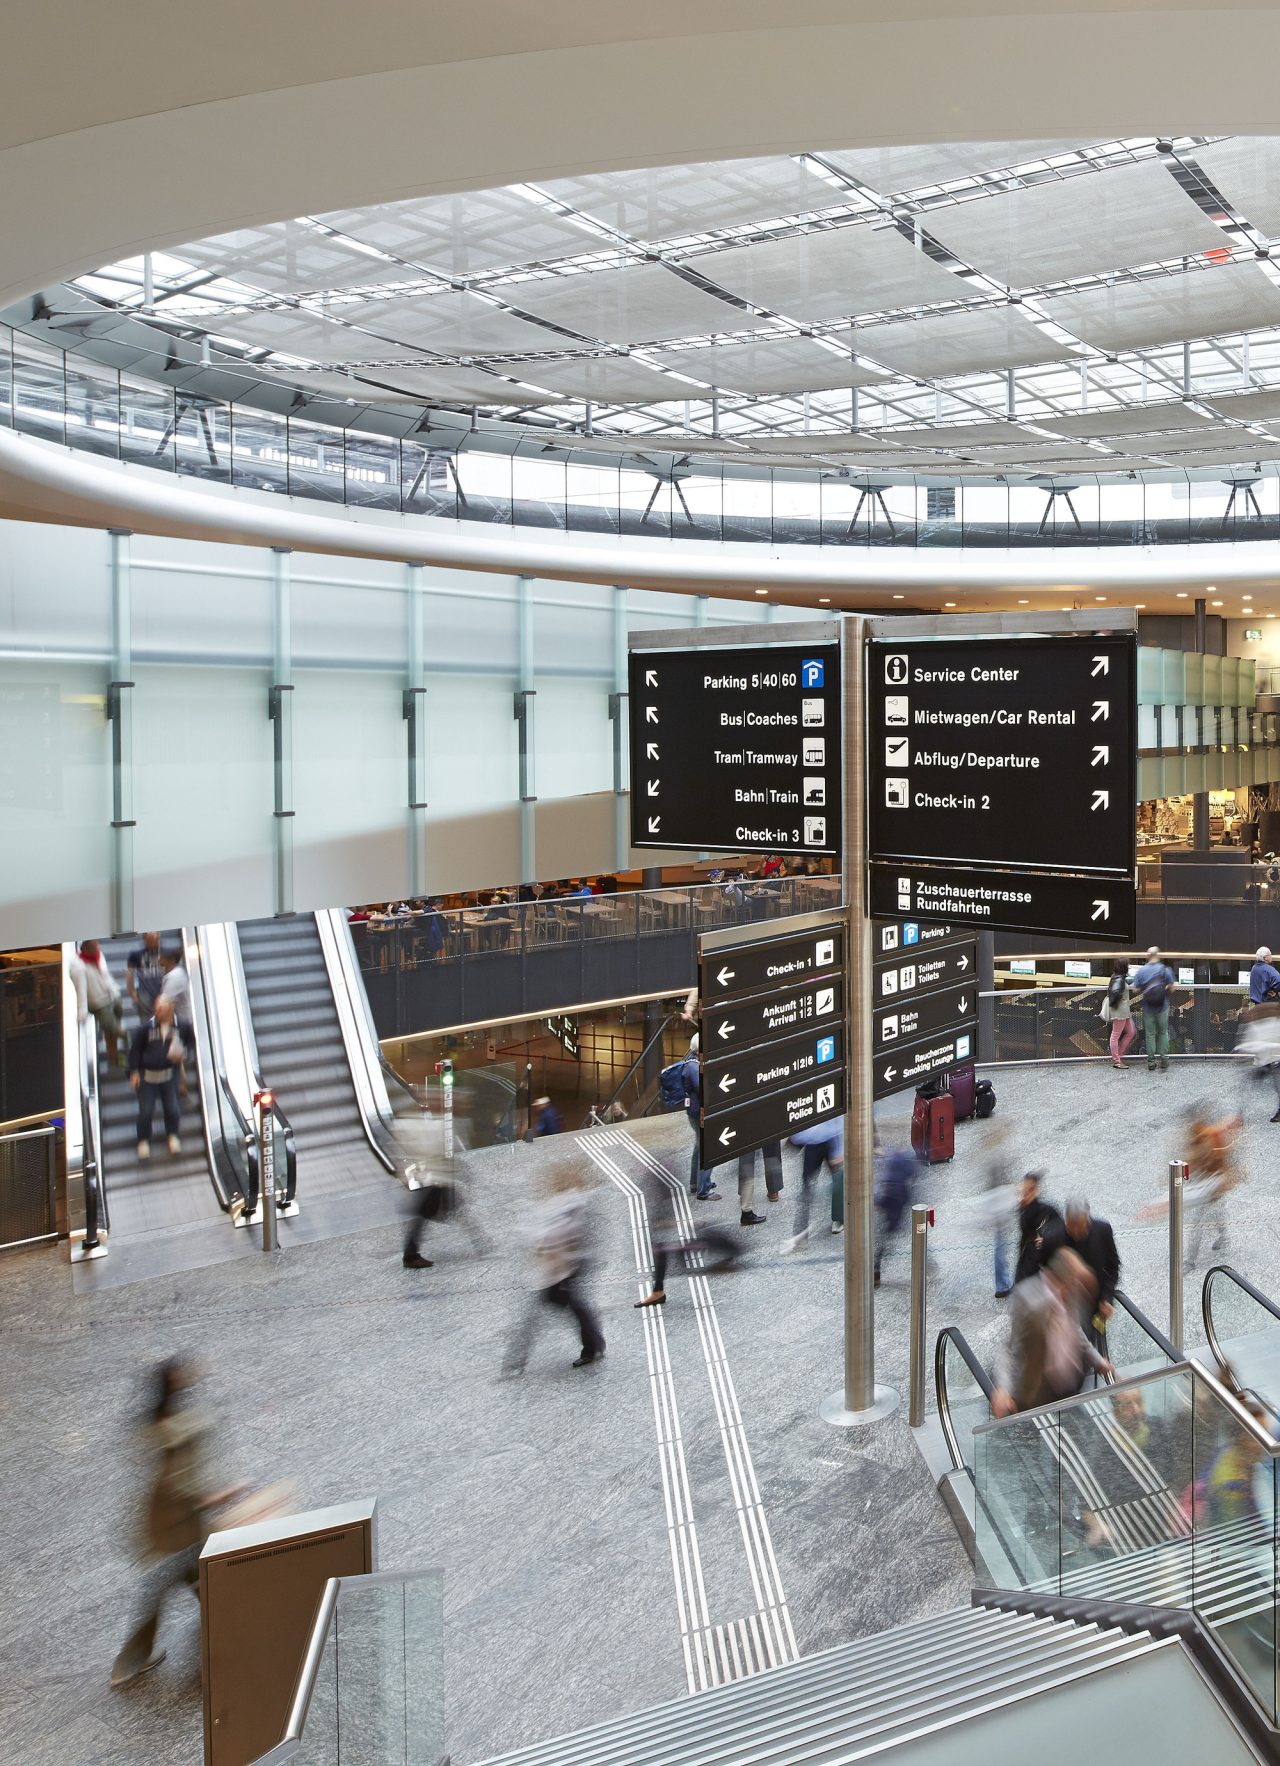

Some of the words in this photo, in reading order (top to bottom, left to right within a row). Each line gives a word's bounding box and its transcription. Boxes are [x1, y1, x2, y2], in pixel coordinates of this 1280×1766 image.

[704, 676, 747, 690] Parking
[914, 668, 965, 682] Service
[971, 667, 1019, 681] Center
[915, 710, 1022, 727] Mietwagen/Car
[1029, 710, 1075, 724] Rental
[914, 752, 1039, 769] Abflug/Departure
[915, 793, 975, 808] Check-in
[982, 795, 990, 809] 2
[736, 827, 787, 841] Check-in
[792, 830, 799, 842] 3
[917, 882, 1032, 903] Zuschauerterrasse
[917, 897, 991, 916] Rundfahrten
[921, 928, 944, 941] Parking
[945, 926, 951, 934] 3
[767, 960, 804, 977] Check-in
[807, 958, 811, 966] 1
[918, 961, 945, 974] Toiletten
[918, 972, 940, 984] Toilets
[763, 1000, 796, 1019] Ankunft
[901, 1012, 918, 1024] Bahn
[768, 1012, 797, 1030] Arrival
[901, 1022, 917, 1033] Train
[915, 1044, 954, 1063] Raucherzone
[903, 1061, 931, 1078] Smoking
[932, 1053, 954, 1067] Lounge
[757, 1066, 789, 1083] Parking
[787, 1093, 813, 1111] Polizei
[788, 1105, 813, 1122] Police
